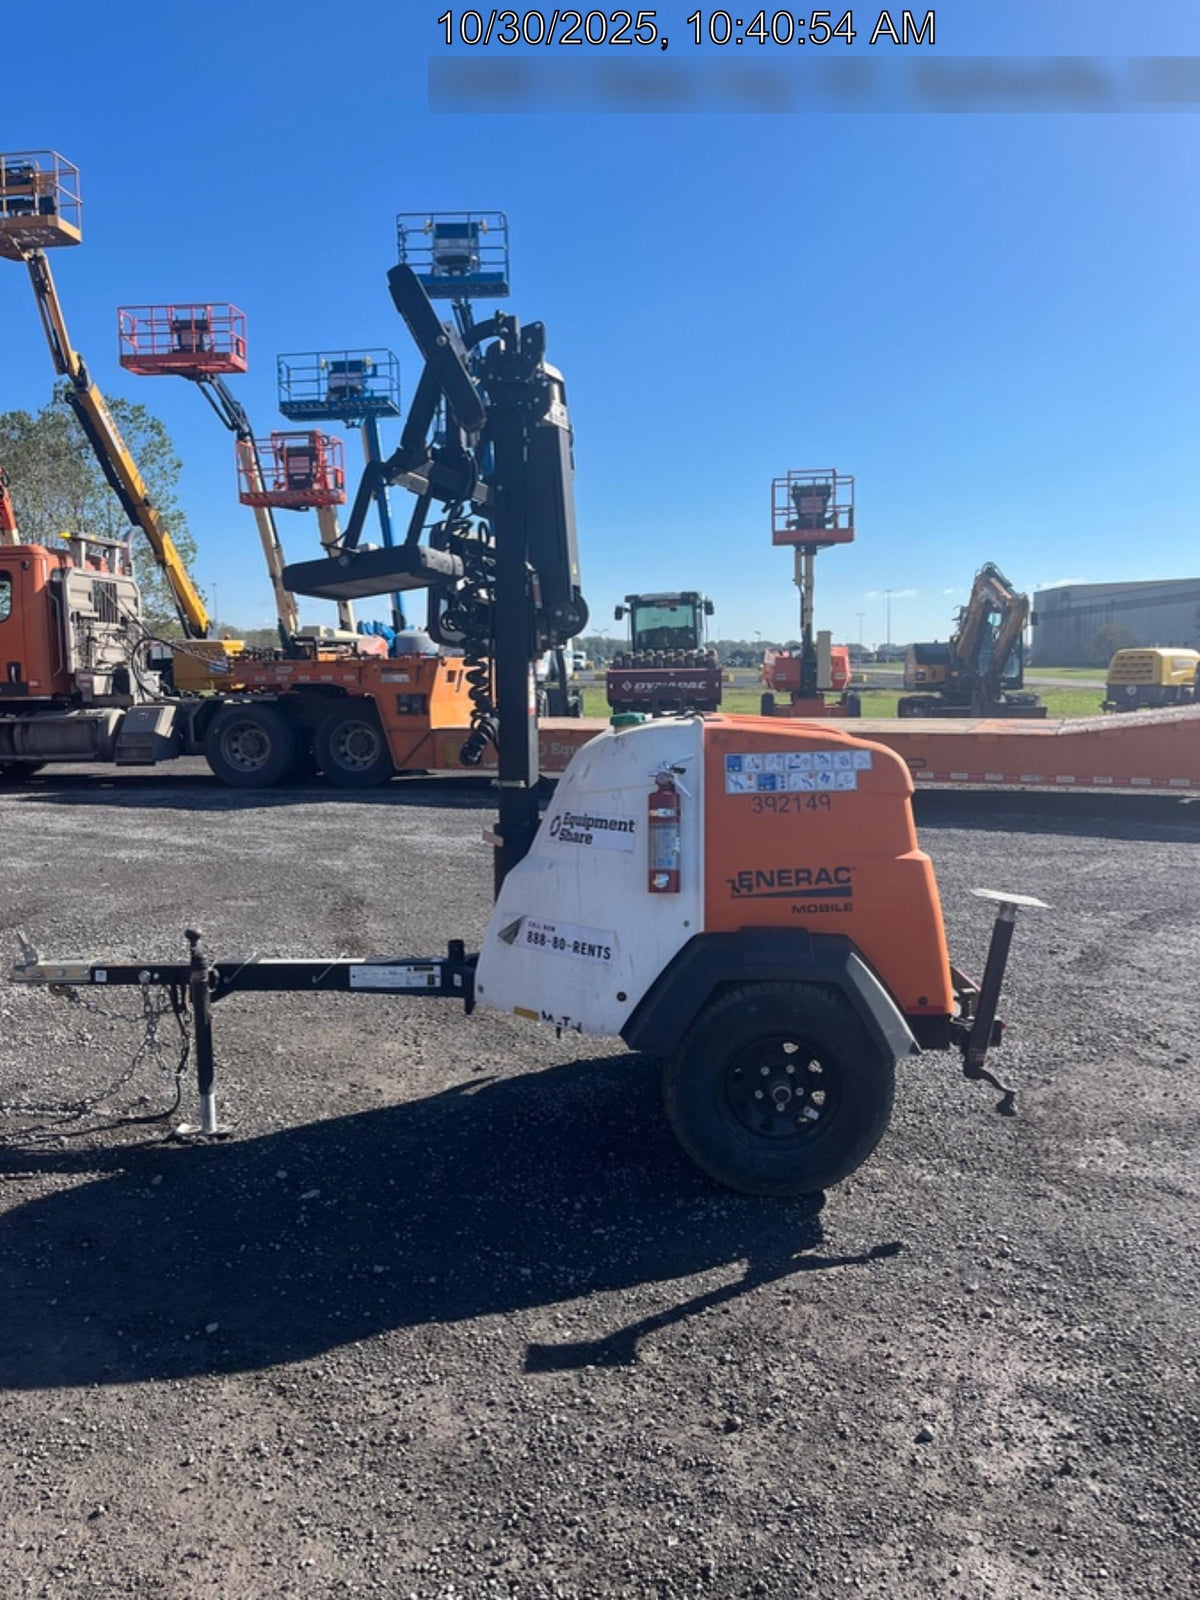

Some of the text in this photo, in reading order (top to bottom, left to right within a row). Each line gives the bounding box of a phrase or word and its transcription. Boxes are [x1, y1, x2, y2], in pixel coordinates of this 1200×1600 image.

[751, 794, 832, 814] 392149
[563, 811, 636, 834] Equipment
[559, 827, 593, 845] Share
[792, 902, 853, 914] MOBILE
[526, 930, 611, 960] 888-80-RENTS
